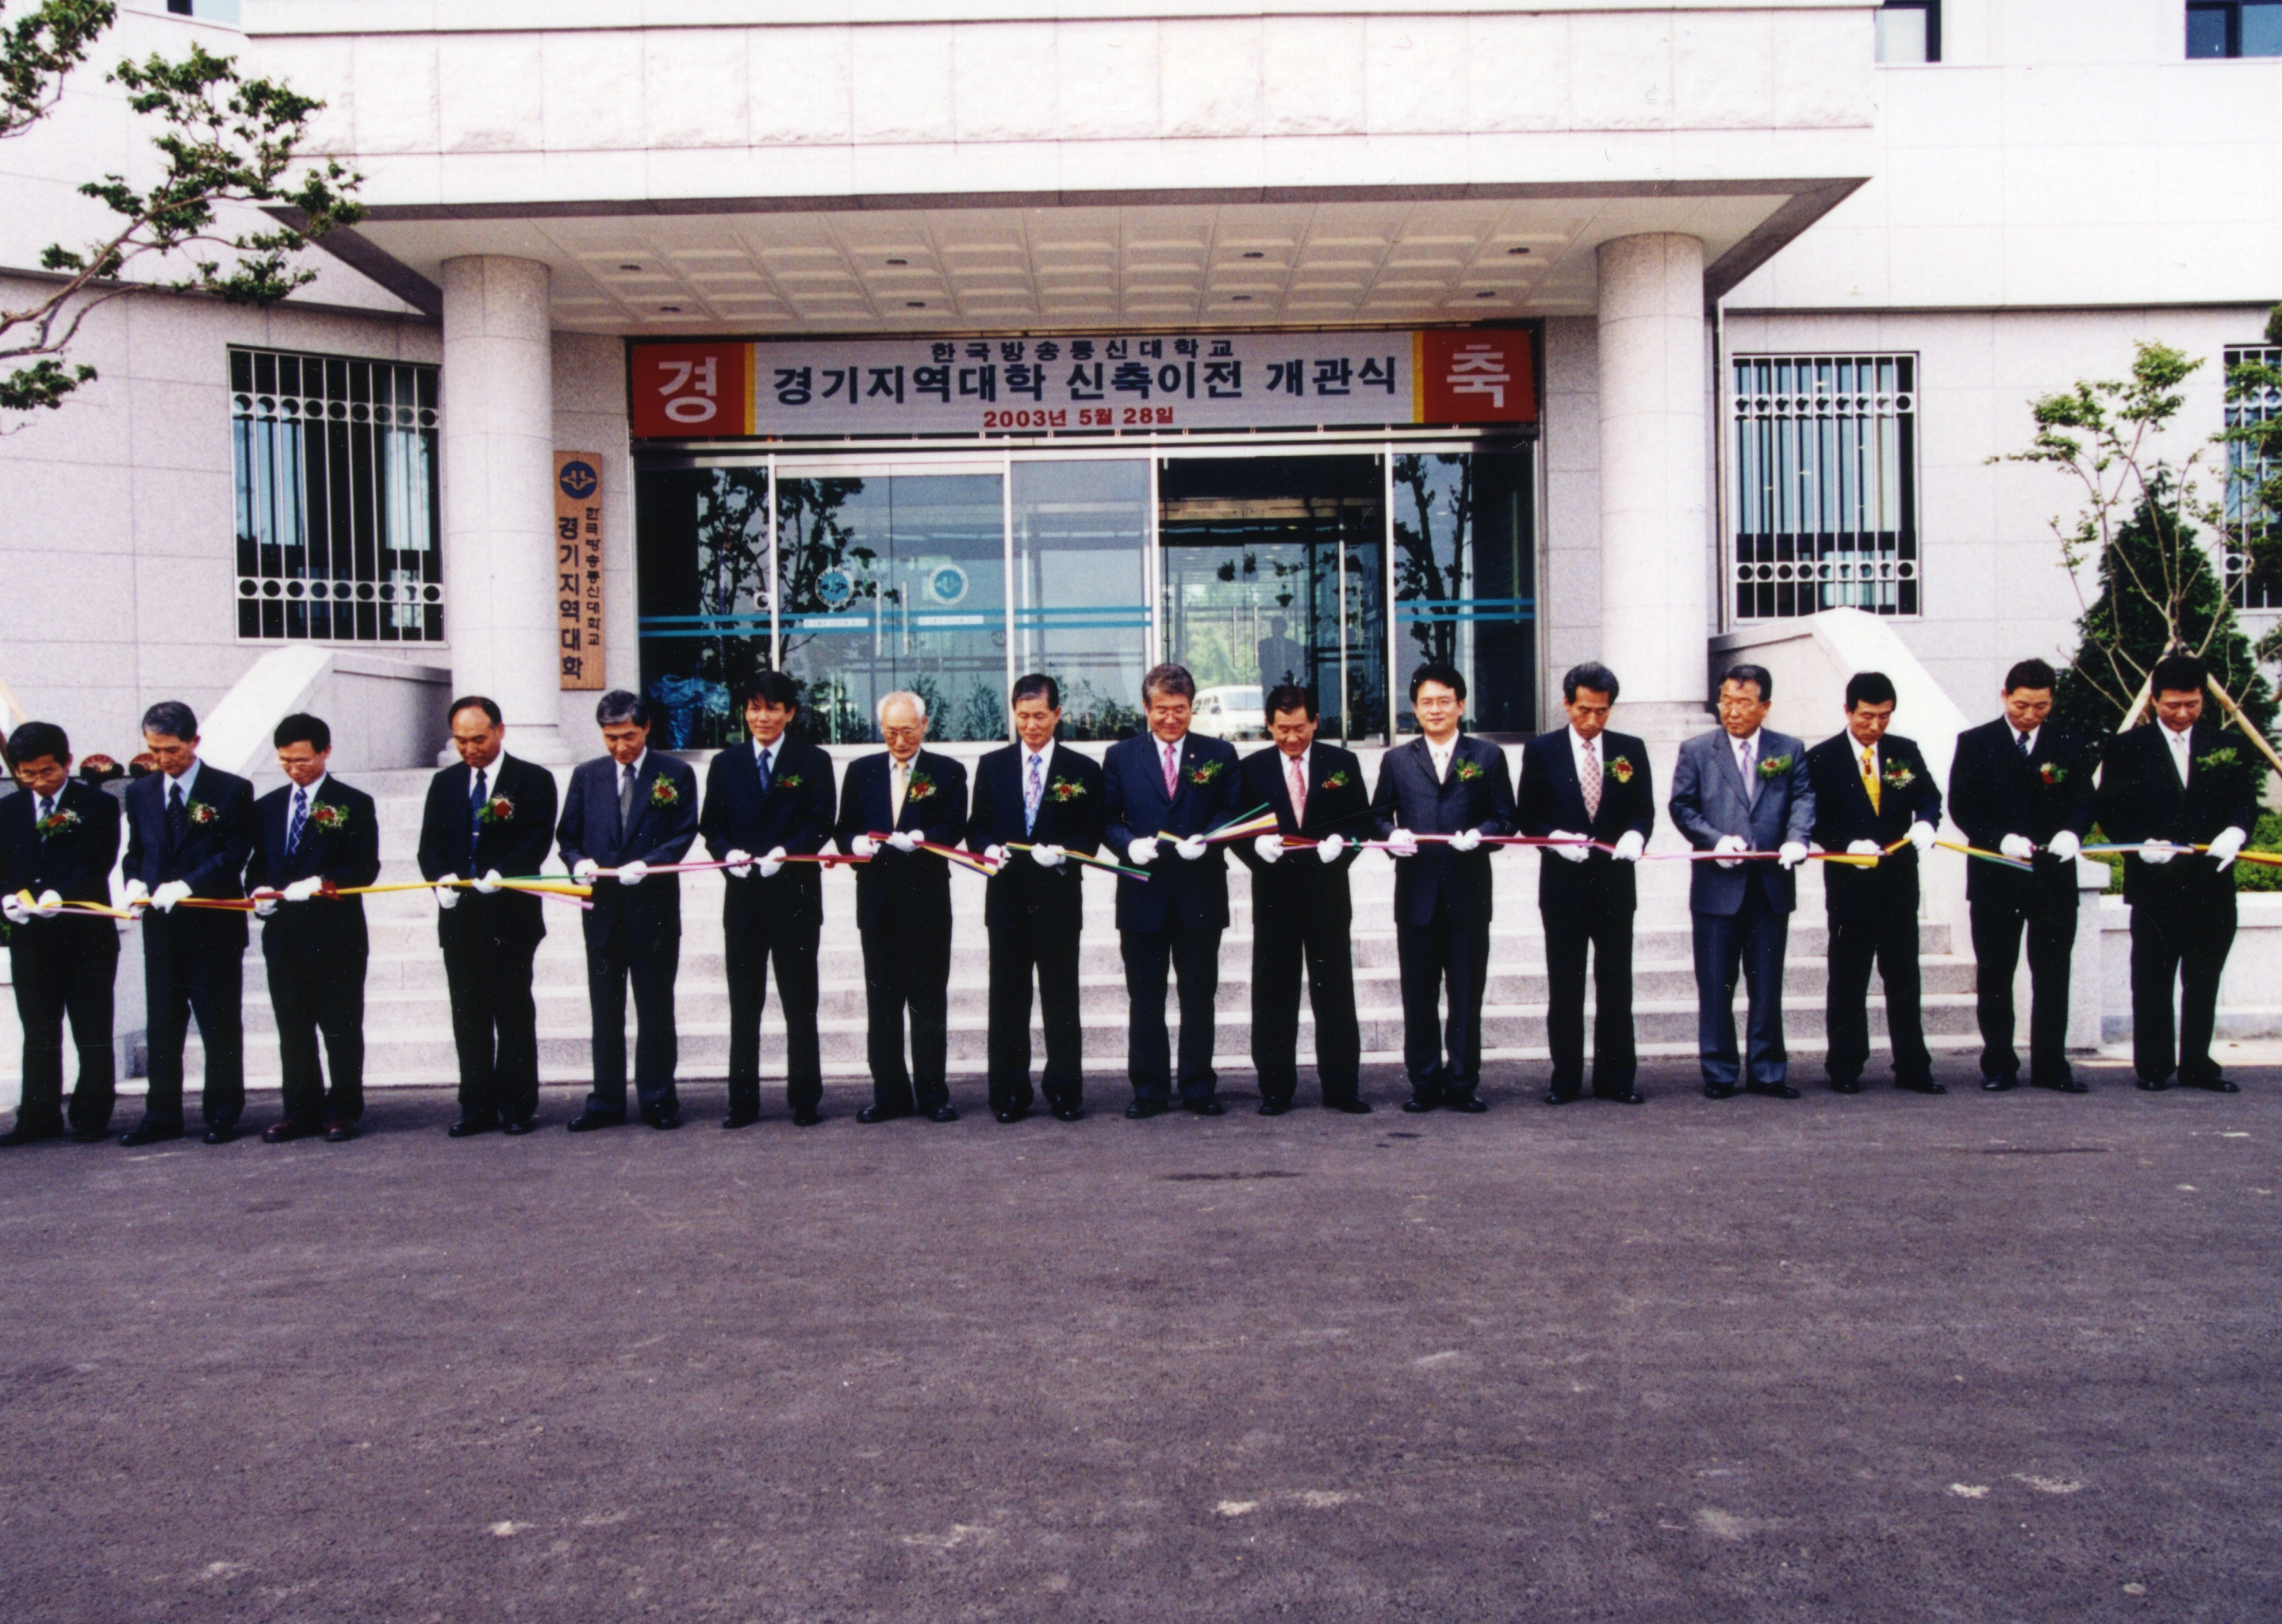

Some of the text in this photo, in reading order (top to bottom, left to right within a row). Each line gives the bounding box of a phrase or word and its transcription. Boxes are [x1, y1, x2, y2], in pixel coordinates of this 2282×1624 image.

[931, 339, 1234, 362] 한국방송통신대학교
[1446, 344, 1511, 408] 축
[658, 356, 718, 423] 경
[773, 356, 1397, 405] 경기지역대학 신축이전 개관식
[983, 406, 1175, 429] 2003년 5월 28일
[558, 516, 583, 680] 경기지역대학
